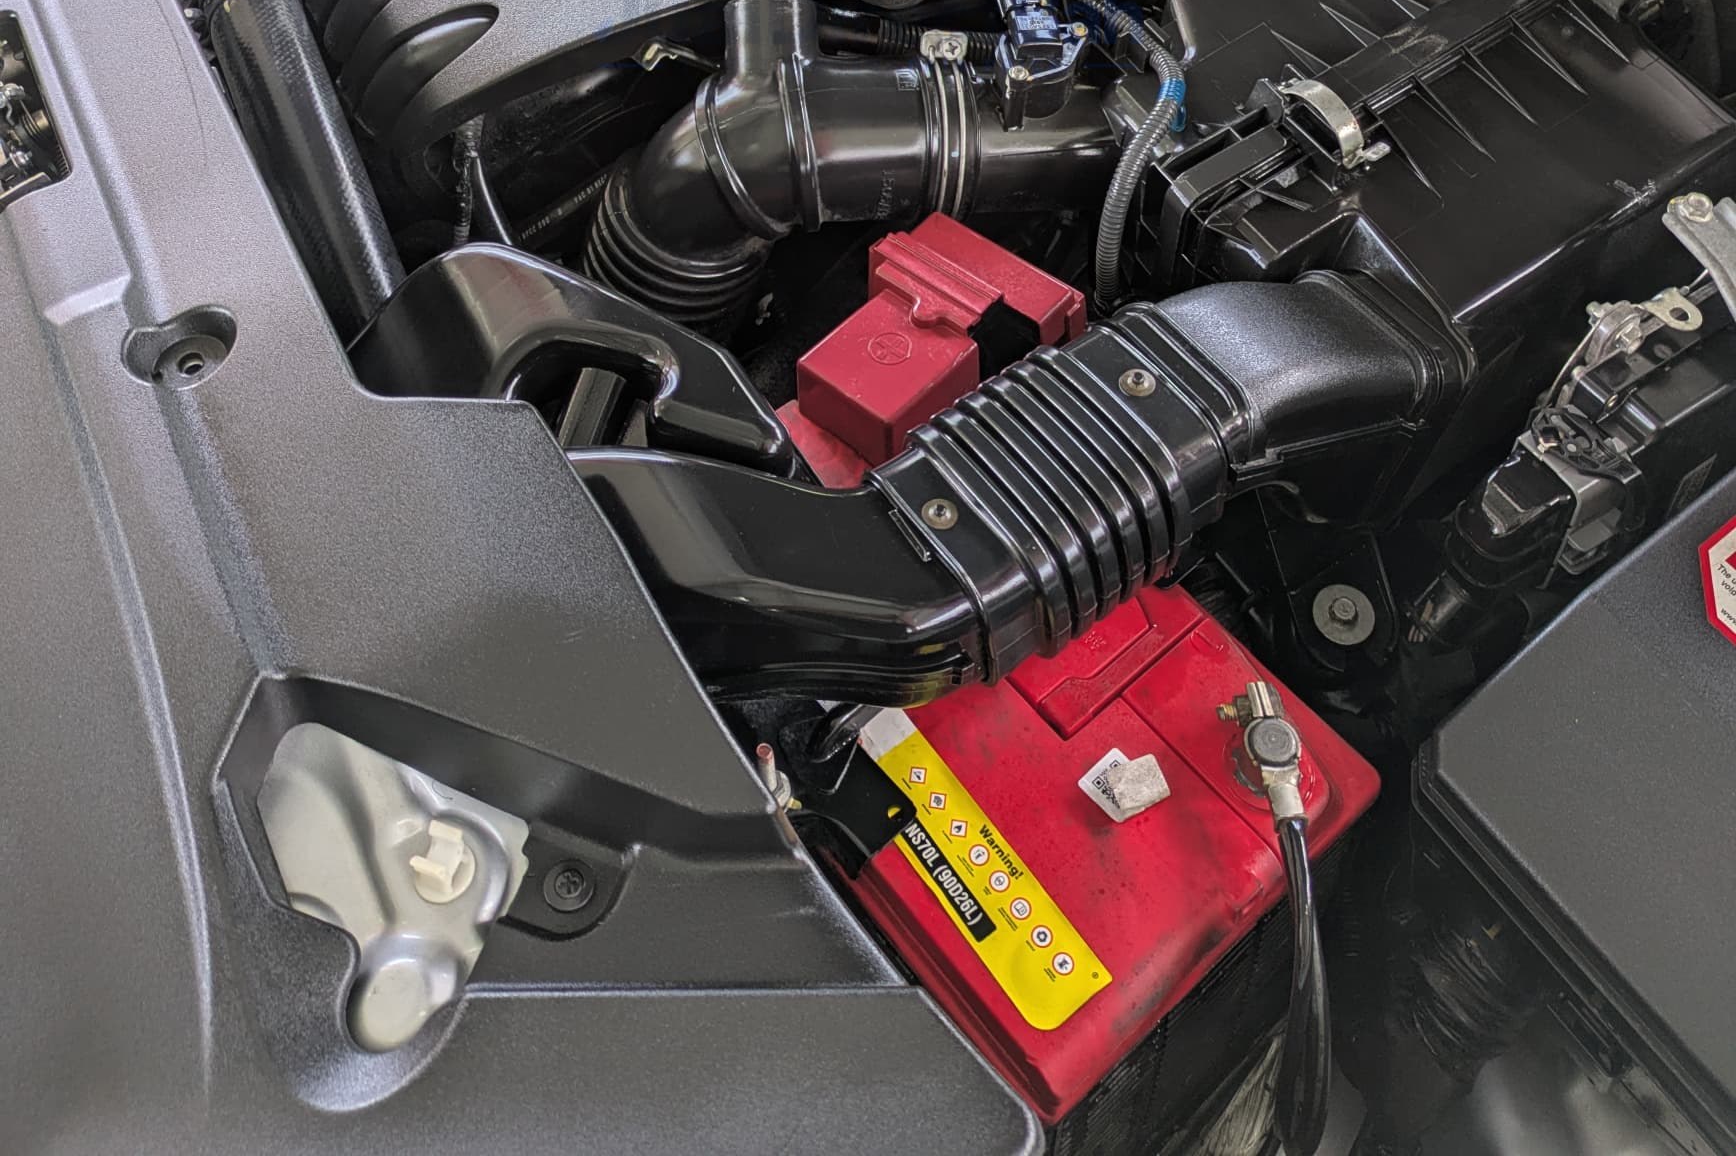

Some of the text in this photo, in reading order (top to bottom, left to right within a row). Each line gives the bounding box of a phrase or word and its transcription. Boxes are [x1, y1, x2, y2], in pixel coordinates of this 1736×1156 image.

[1717, 563, 1731, 579] The
[905, 823, 940, 868] NS70L
[932, 865, 983, 926] (90D26L)
[979, 824, 1024, 880] Warning!
